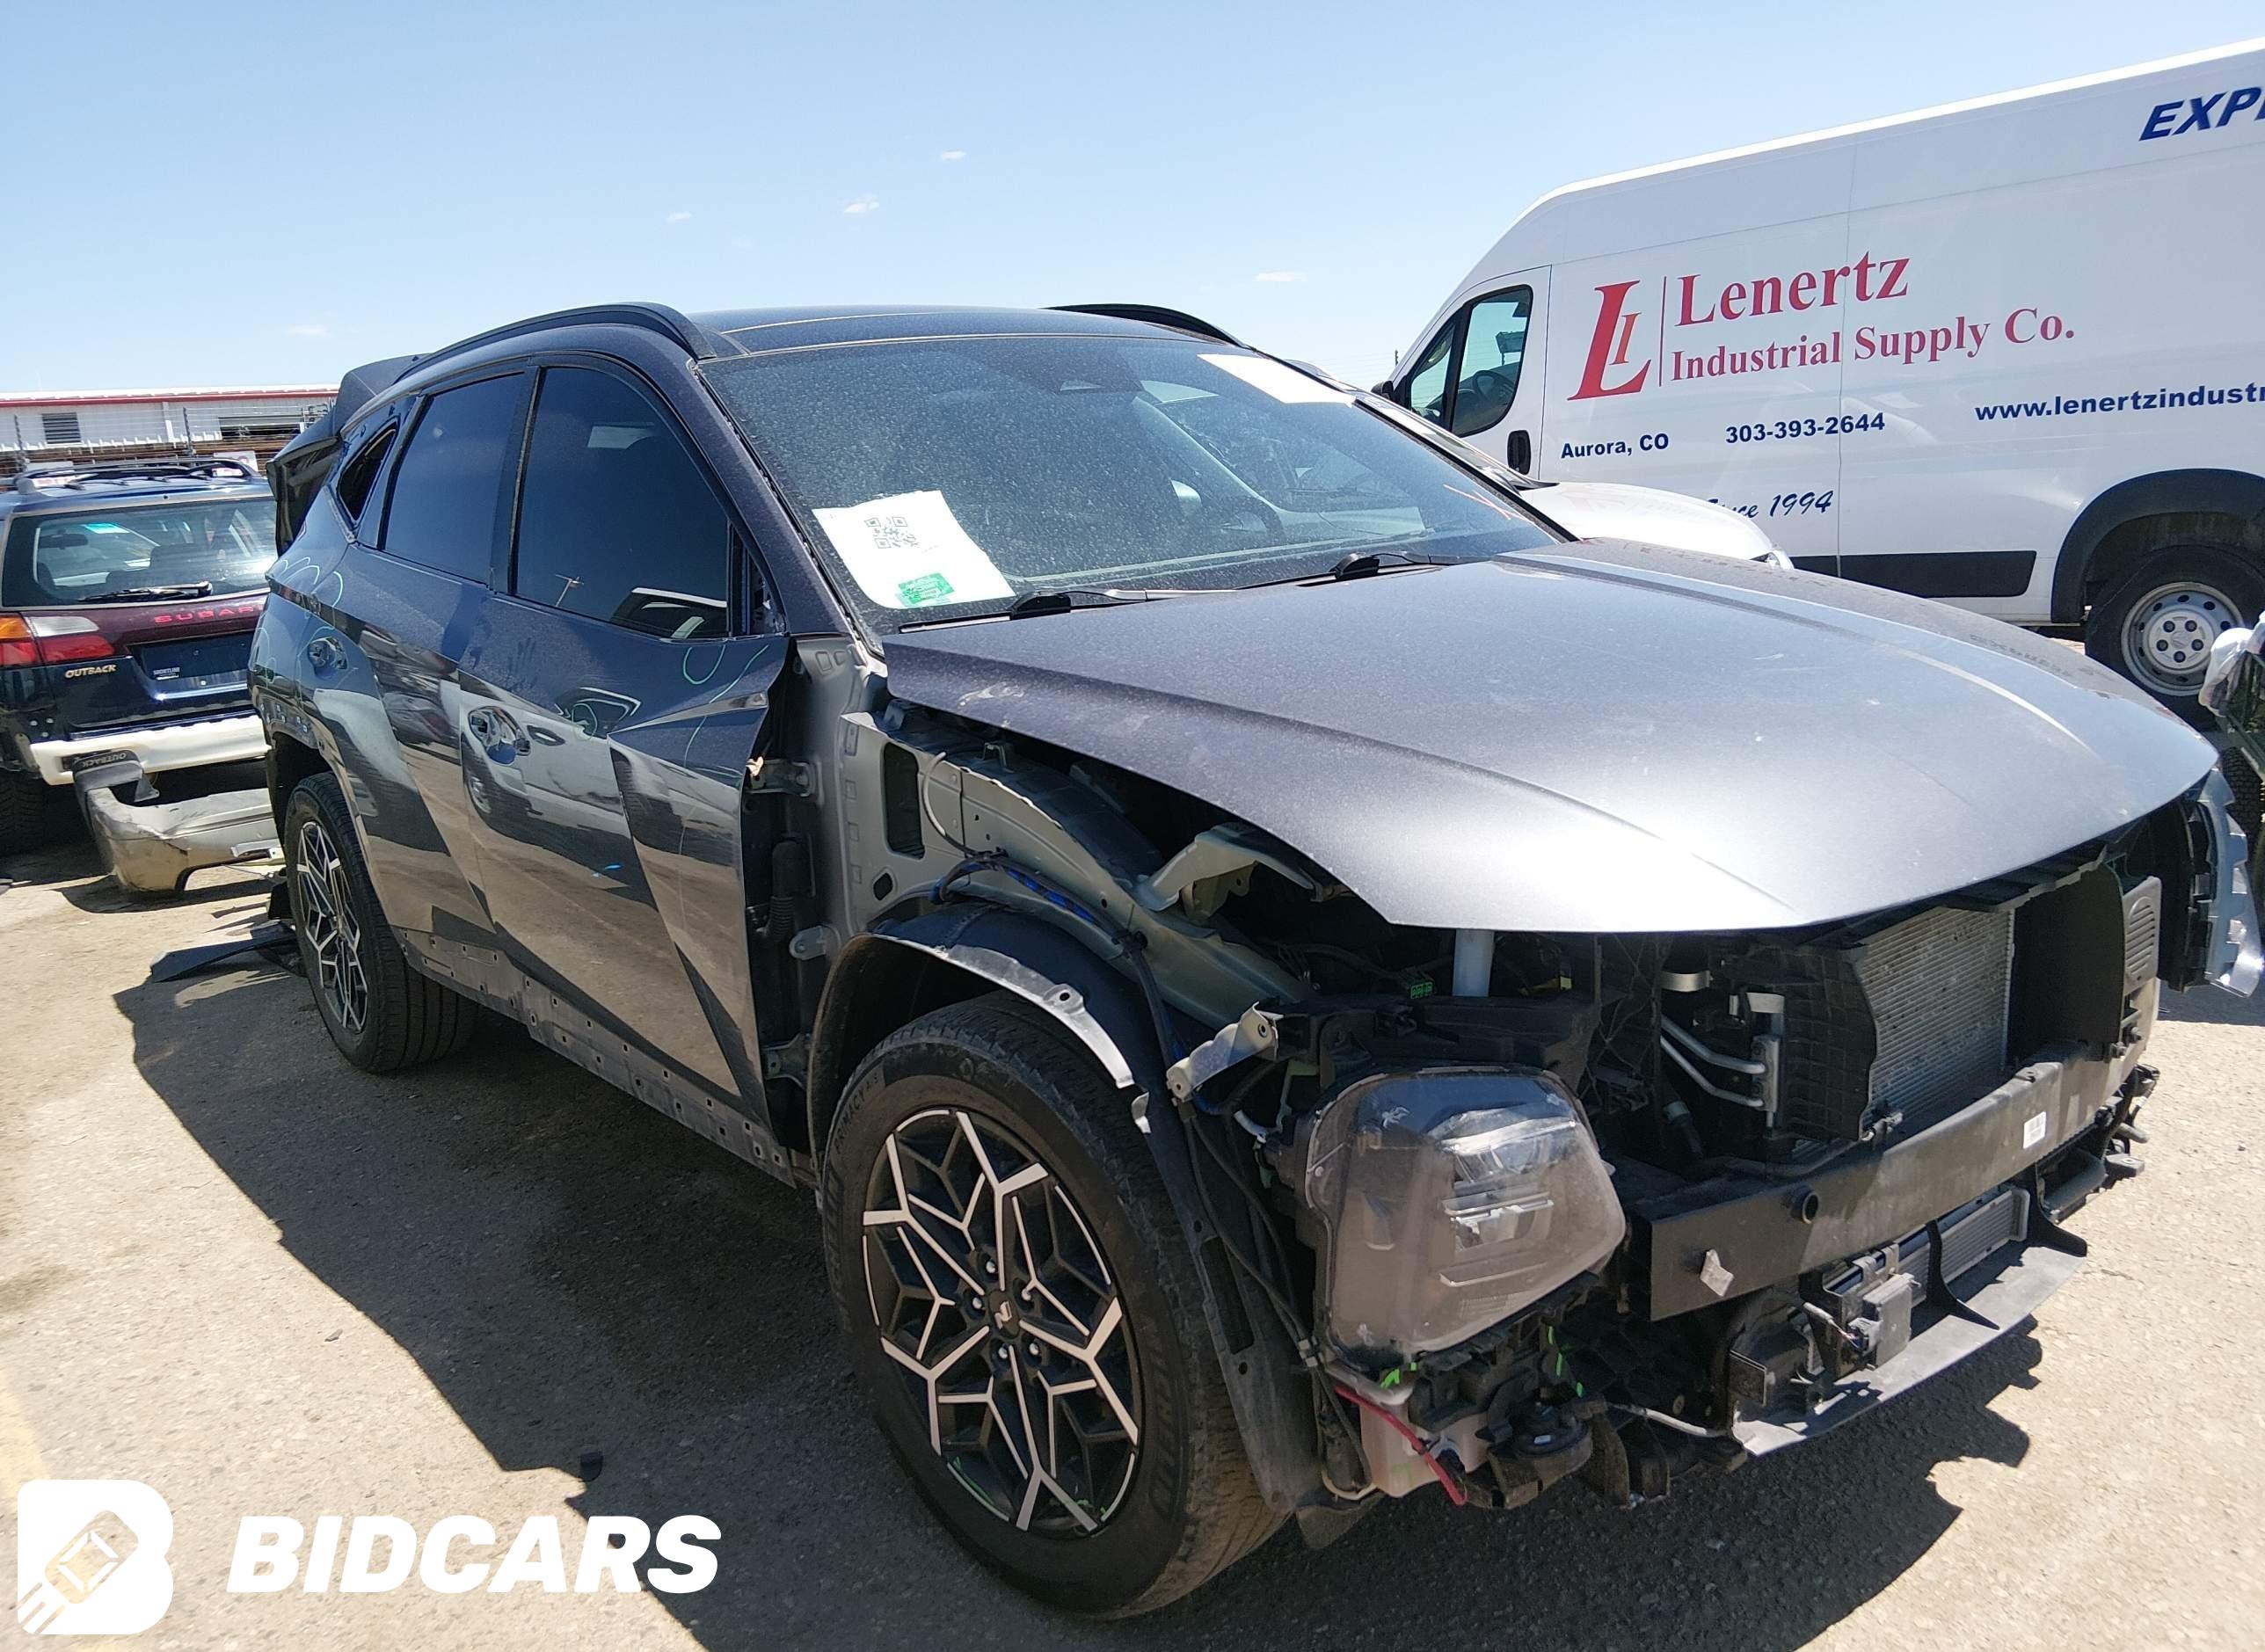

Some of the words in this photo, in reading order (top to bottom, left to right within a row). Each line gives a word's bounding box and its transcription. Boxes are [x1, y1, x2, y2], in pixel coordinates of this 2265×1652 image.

[2138, 86, 2265, 141] EXP
[1674, 251, 1910, 326] Lenertz
[1671, 331, 1843, 381] Industrial
[1854, 316, 1991, 365] Supply
[2005, 308, 2074, 344] Co.
[1725, 411, 1885, 443] 303-393-2644
[1561, 440, 1633, 459] Aurora,
[1639, 433, 1669, 451] CO
[1769, 490, 1833, 517] 1994
[154, 605, 264, 623] SUBAR
[64, 665, 117, 678] OUTBACK
